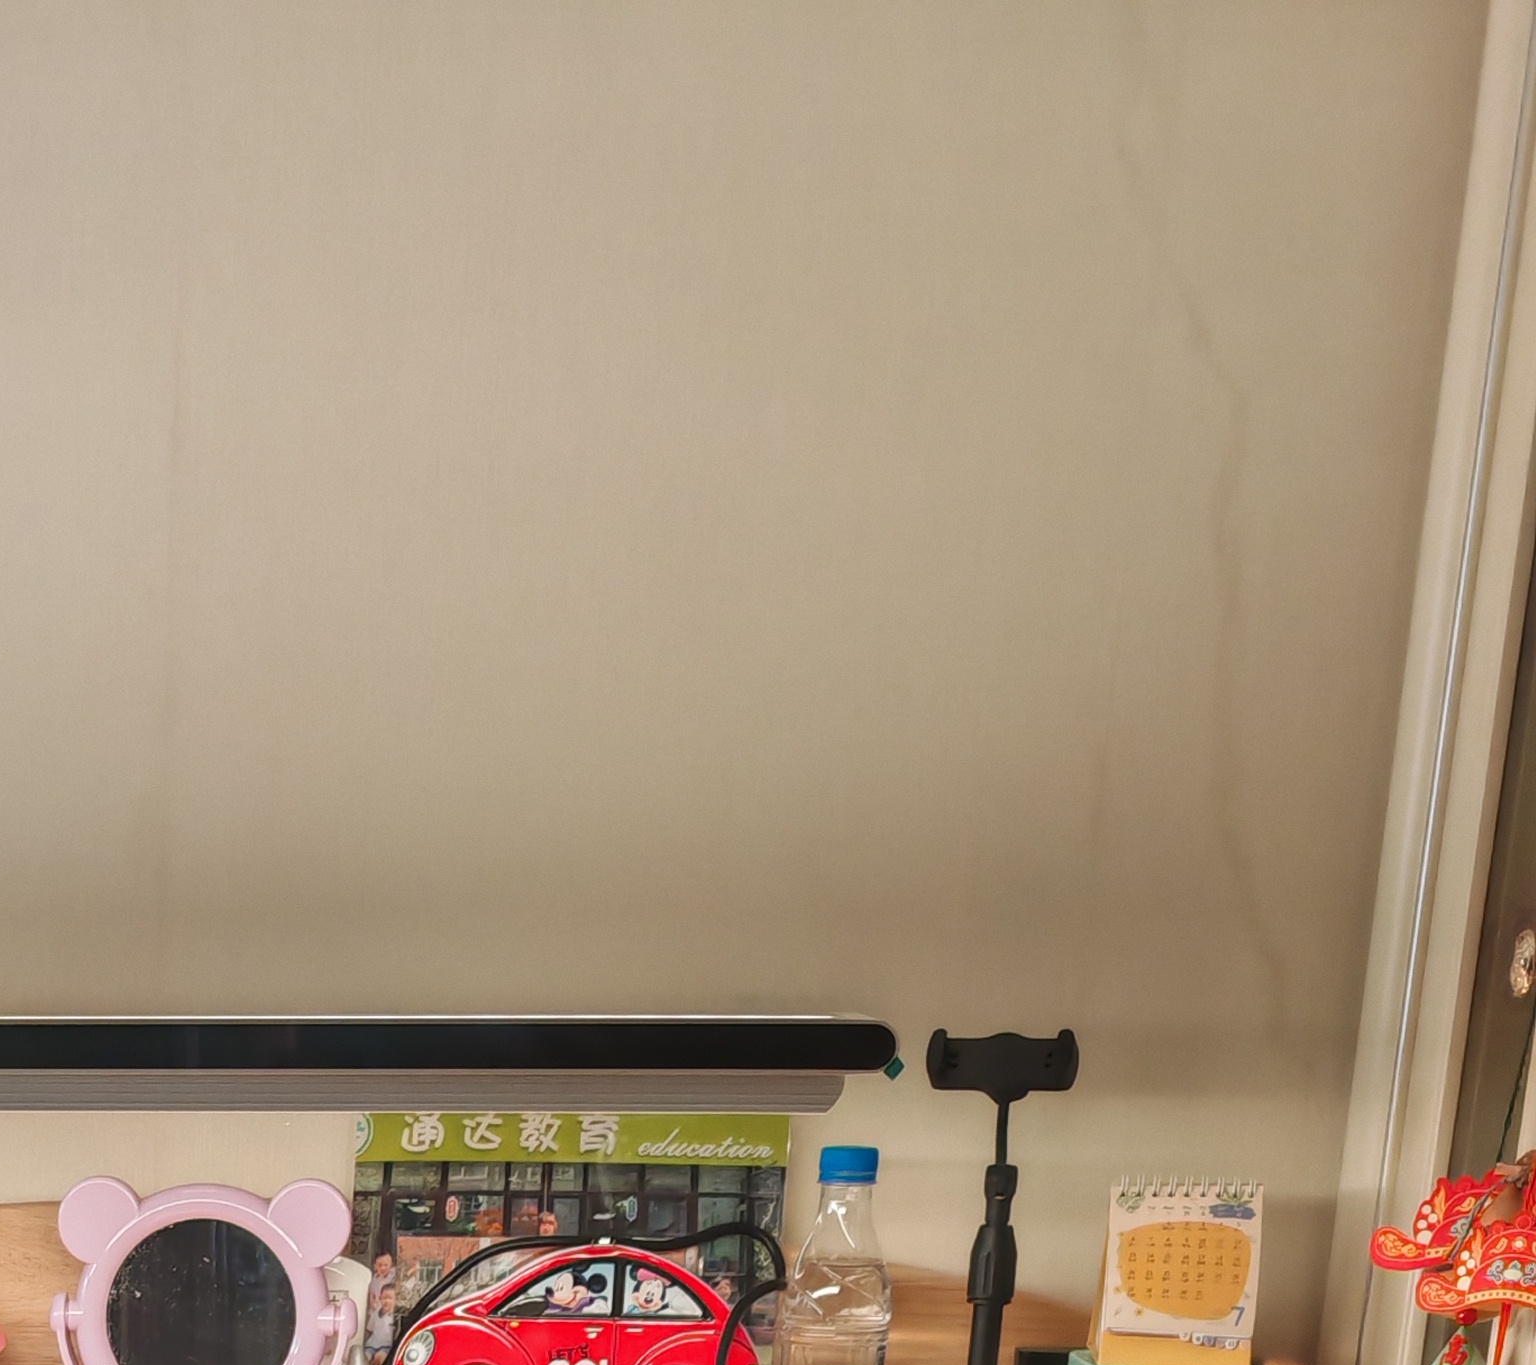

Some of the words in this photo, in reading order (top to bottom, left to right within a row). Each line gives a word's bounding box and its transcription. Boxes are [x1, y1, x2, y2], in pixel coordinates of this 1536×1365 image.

[401, 1114, 620, 1154] 通达教育
[638, 1127, 773, 1160] education
[1231, 1306, 1245, 1327] 7
